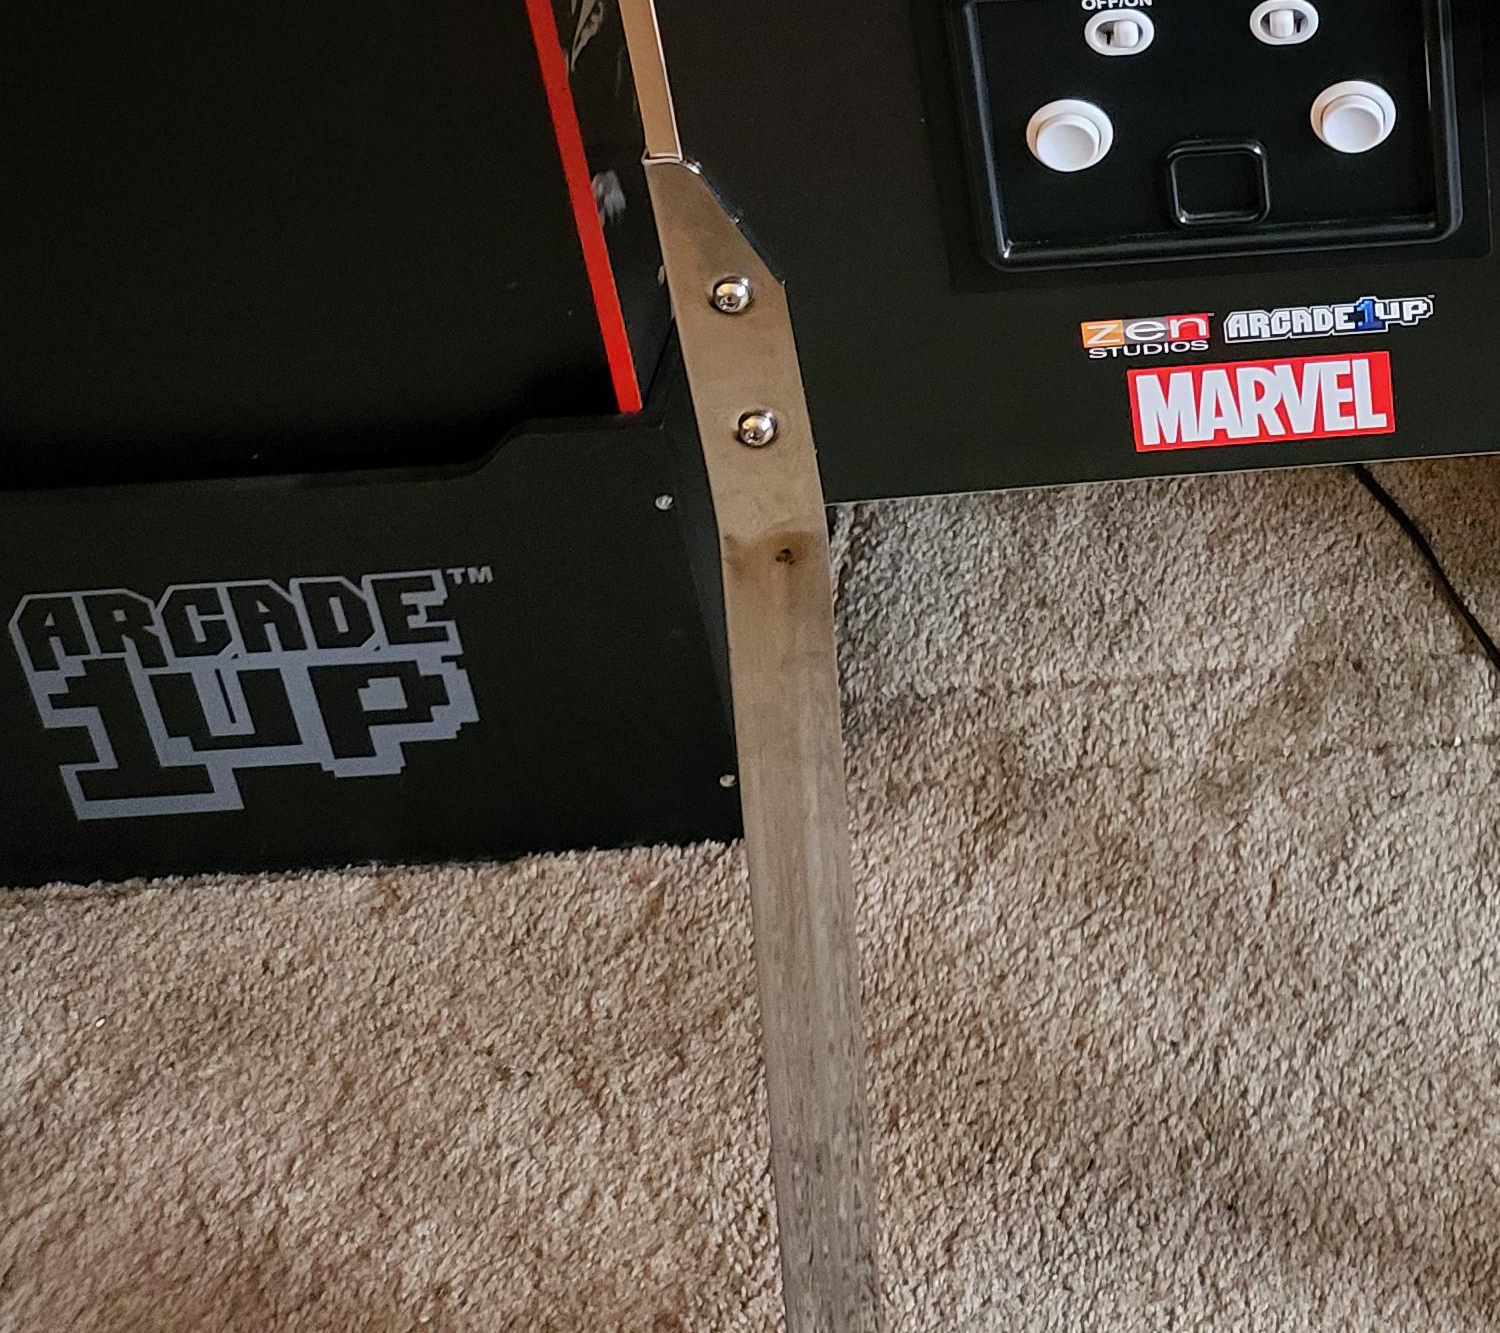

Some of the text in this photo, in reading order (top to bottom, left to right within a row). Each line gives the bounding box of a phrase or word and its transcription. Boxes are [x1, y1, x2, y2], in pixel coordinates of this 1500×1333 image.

[1085, 314, 1209, 345] zen
[1088, 339, 1210, 360] STUDIOS
[1228, 298, 1431, 342] ARCADE1UP
[1135, 358, 1388, 446] MARVEL
[9, 566, 494, 671] ARCADE TM
[45, 656, 481, 821] 1UP
